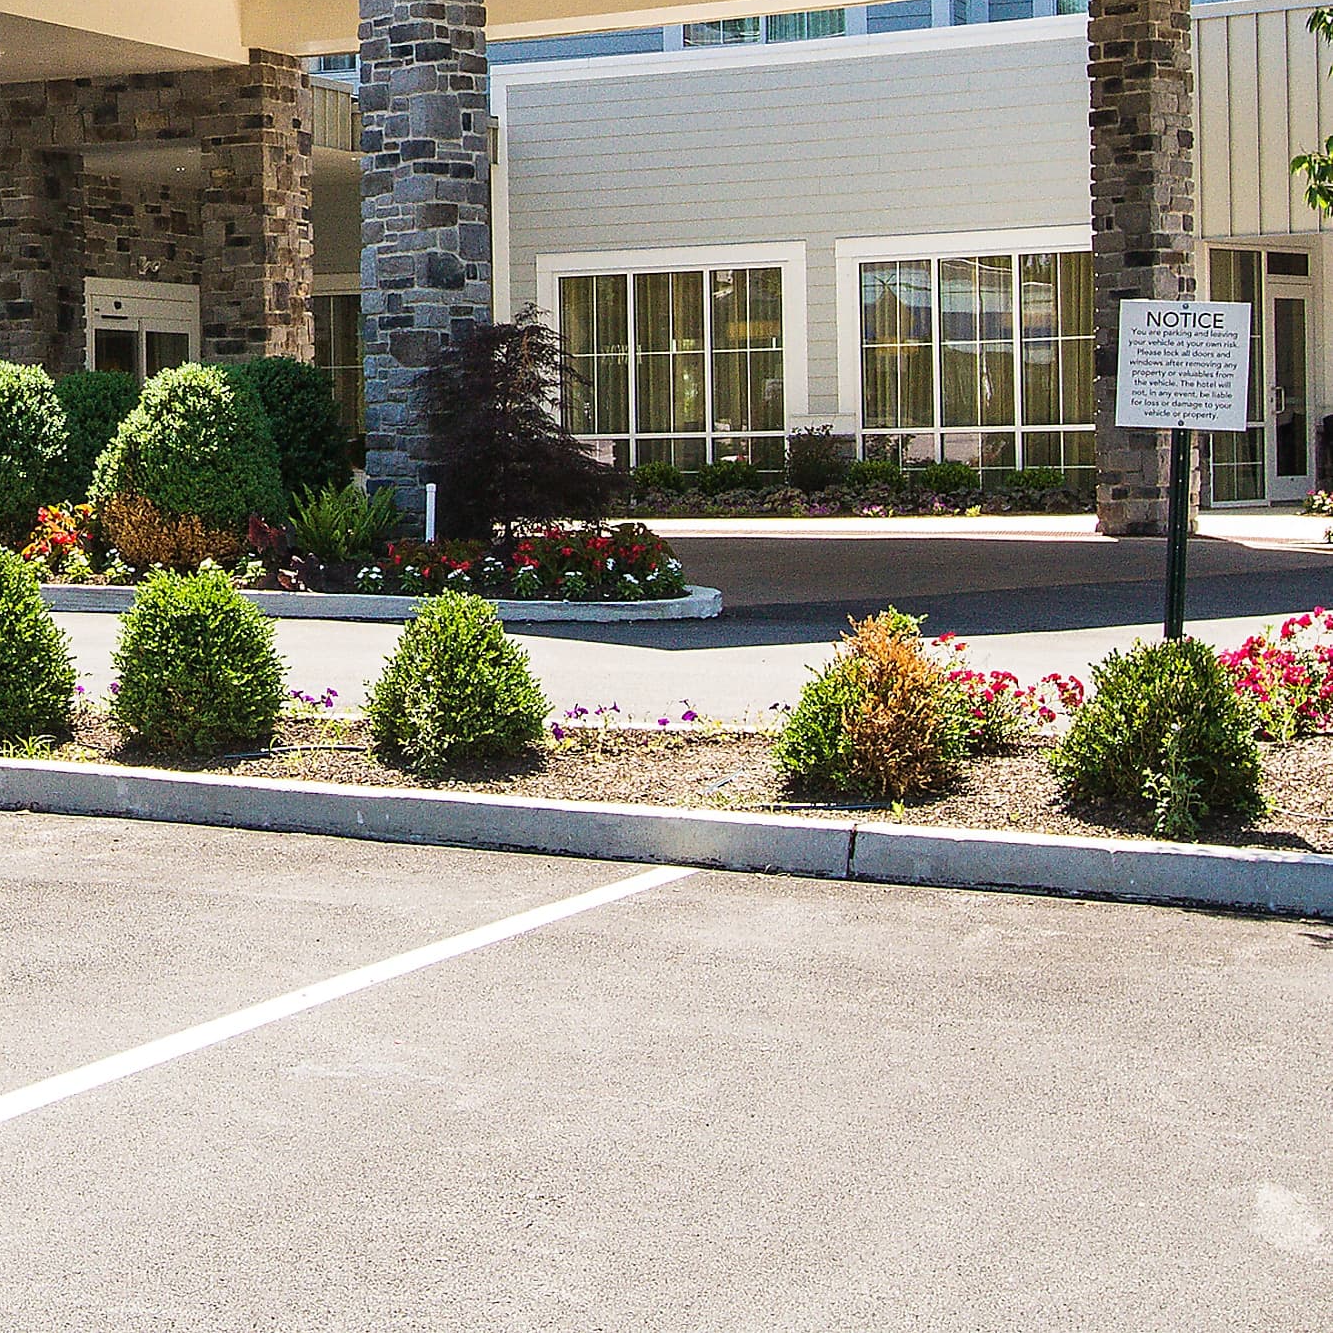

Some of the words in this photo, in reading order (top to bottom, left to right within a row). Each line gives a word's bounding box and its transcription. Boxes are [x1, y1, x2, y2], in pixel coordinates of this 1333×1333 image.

[1146, 311, 1224, 329] NOTICE
[1211, 331, 1238, 339] leaving
[1186, 360, 1221, 368] removing
[1172, 401, 1202, 409] damage
[1183, 411, 1218, 420] property.
